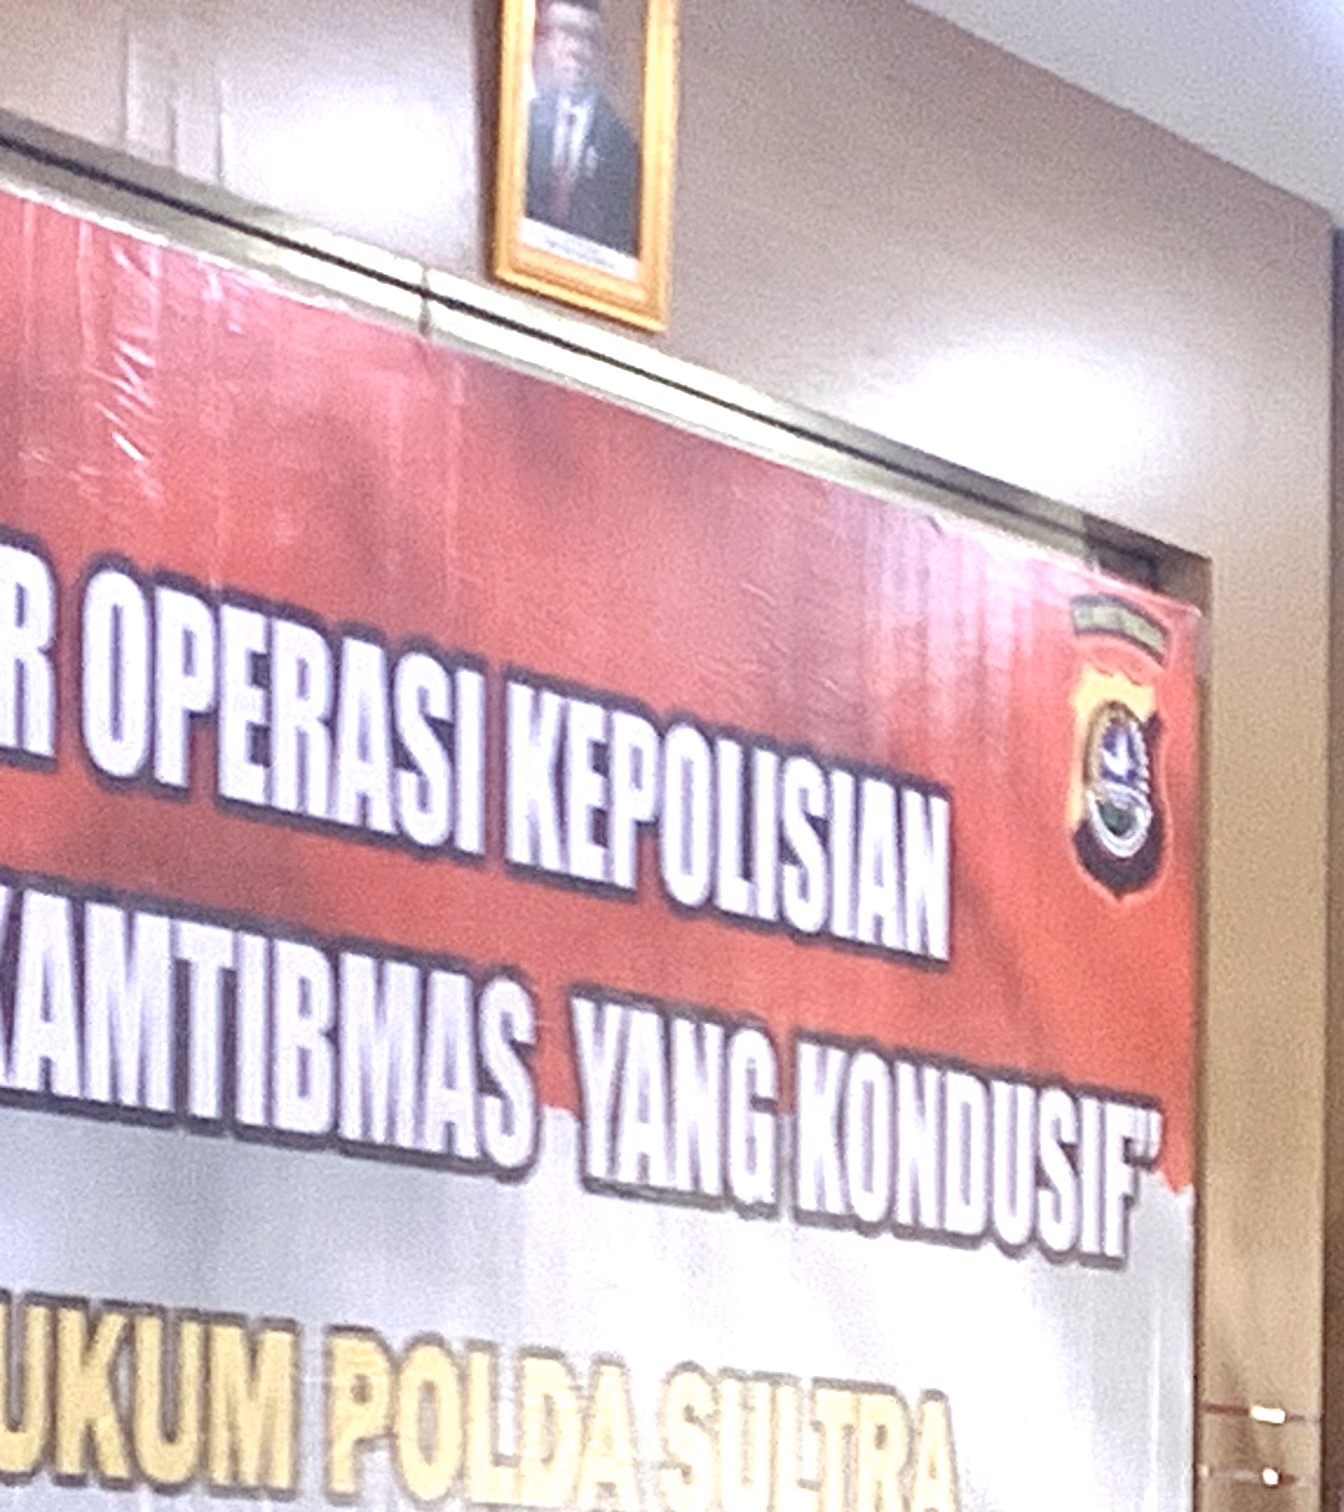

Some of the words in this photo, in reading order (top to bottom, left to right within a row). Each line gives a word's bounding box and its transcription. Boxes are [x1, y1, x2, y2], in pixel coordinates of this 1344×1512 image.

[81, 564, 487, 857] OPERASI
[505, 675, 953, 963] KEPOLISIAN
[568, 994, 778, 1208] YANG
